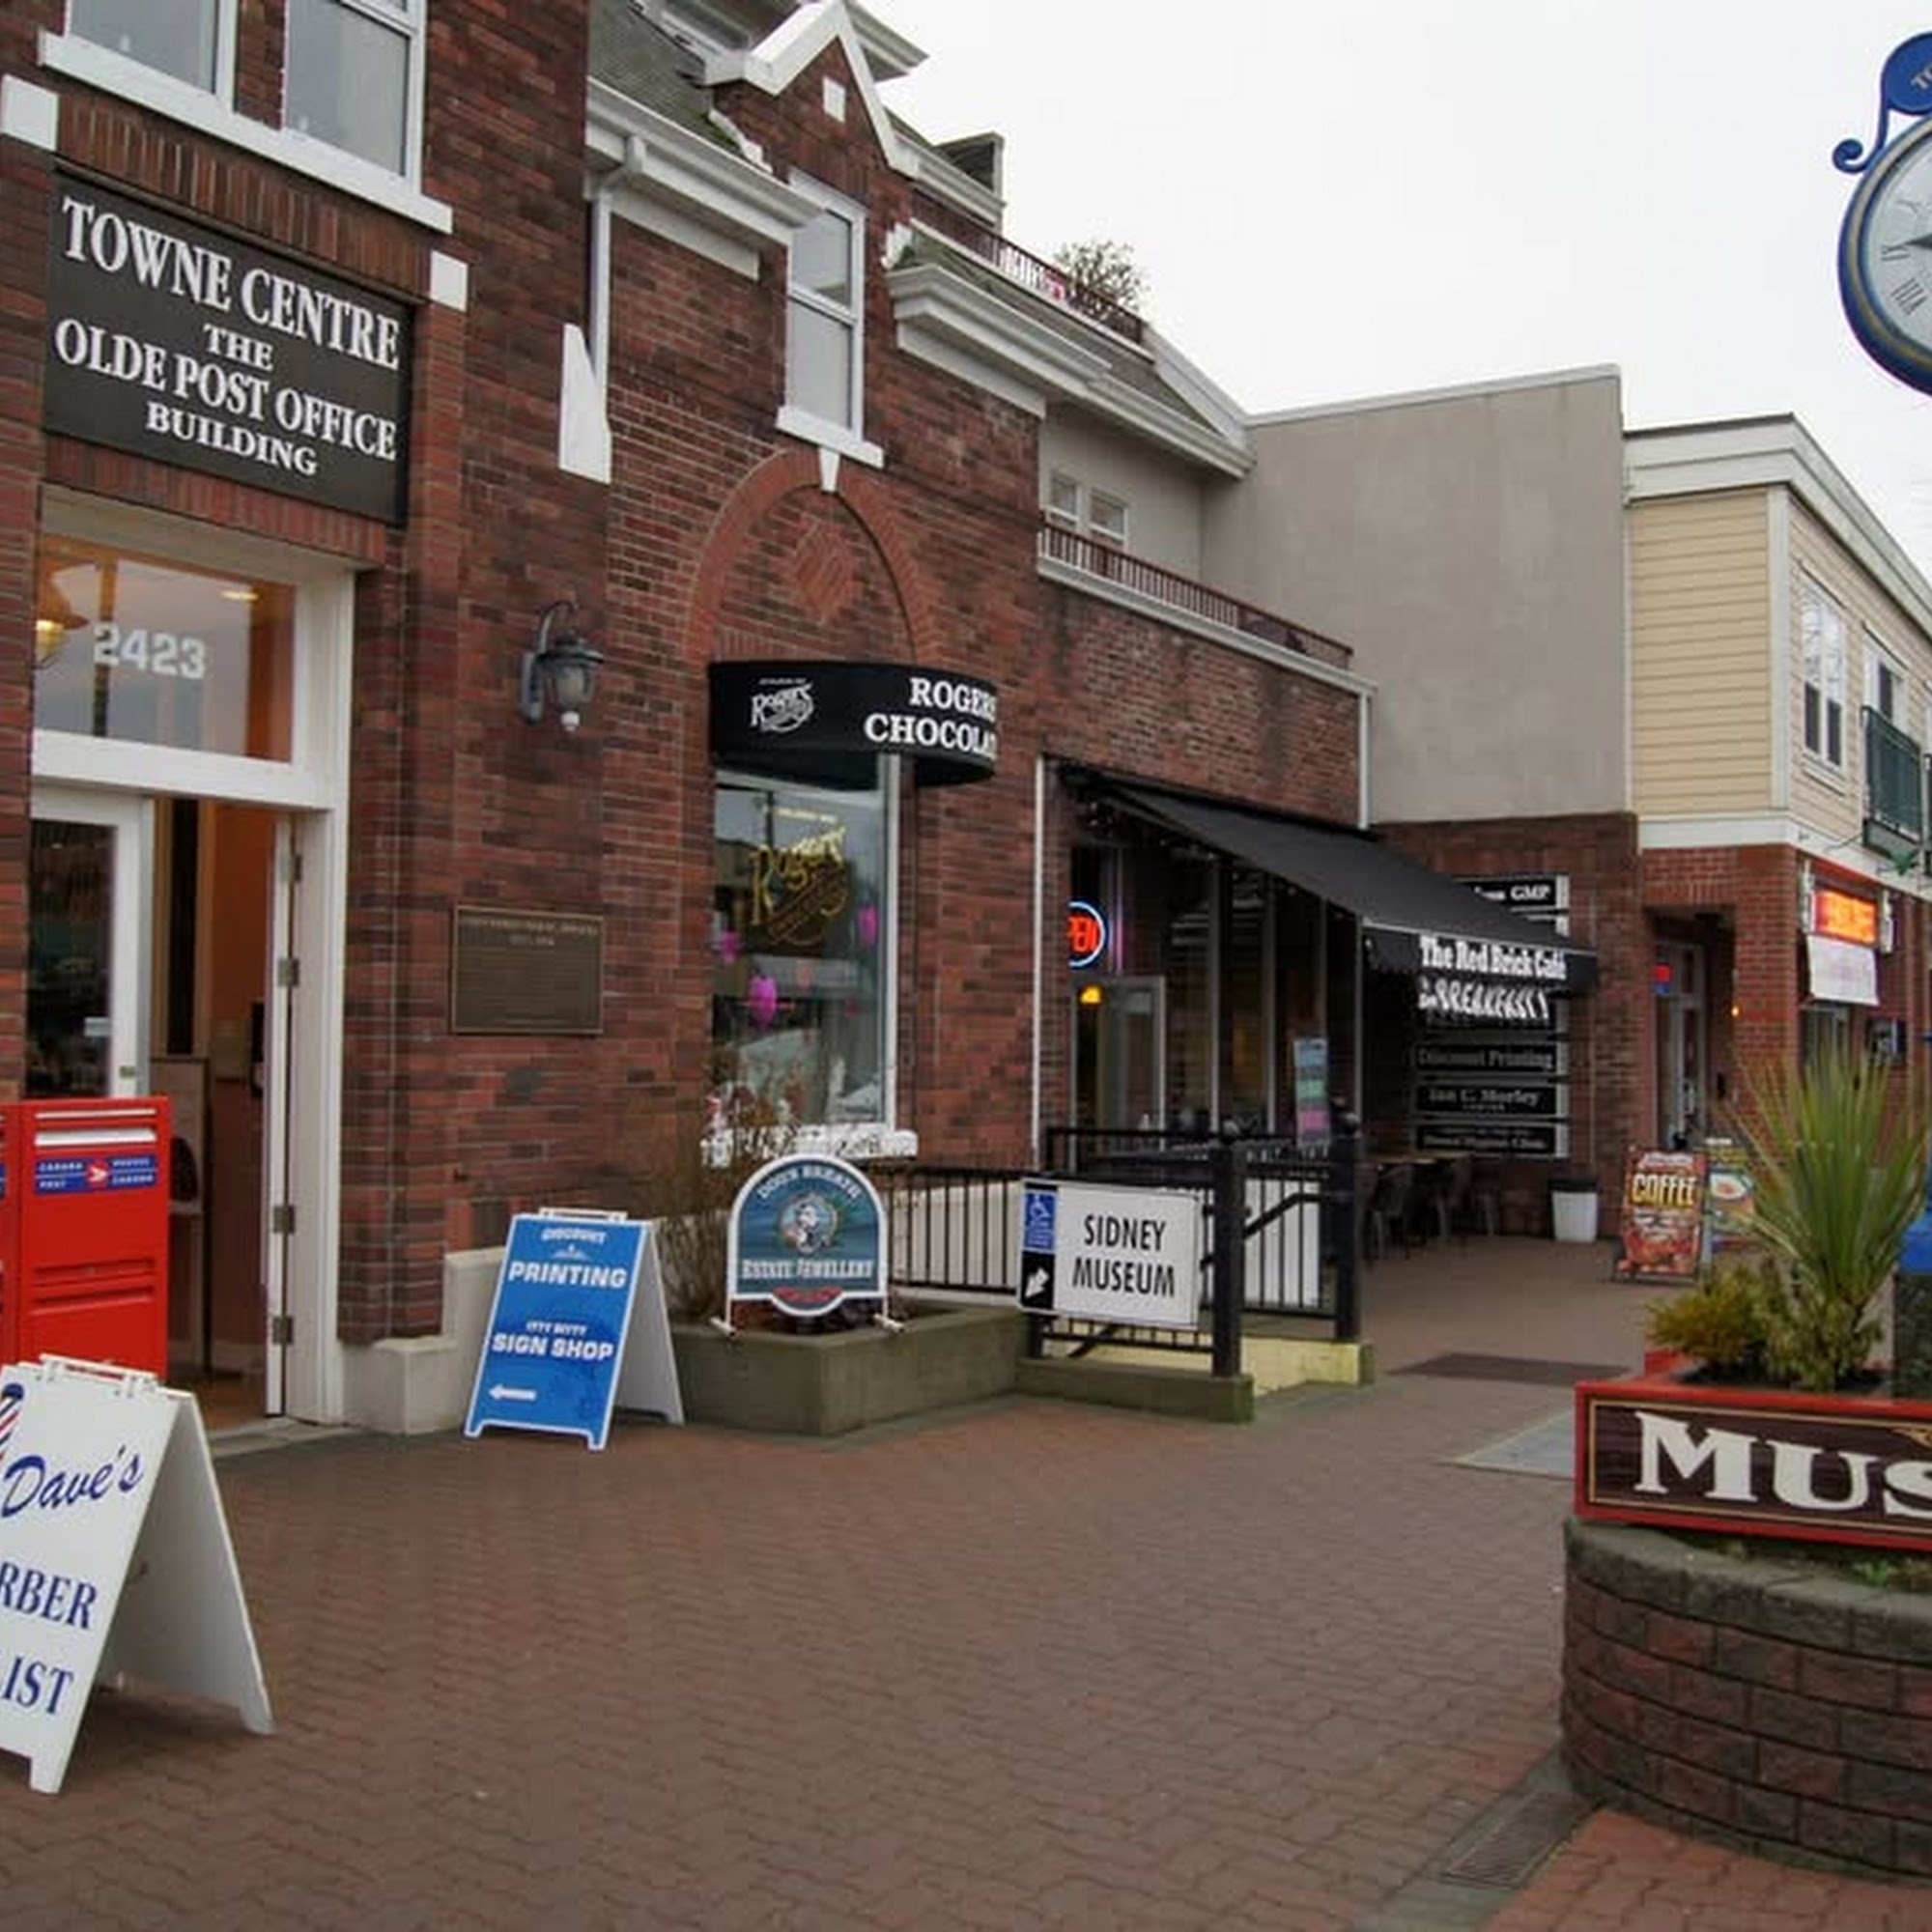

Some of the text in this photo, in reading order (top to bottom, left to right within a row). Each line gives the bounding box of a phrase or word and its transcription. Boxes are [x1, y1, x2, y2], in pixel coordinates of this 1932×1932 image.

[62, 197, 400, 371] TOWNE CENTRE
[203, 324, 273, 371] THE
[55, 318, 397, 461] OLDE POST OFFICE
[146, 401, 318, 475] BUILDING
[94, 621, 207, 680] 2423
[1419, 934, 1453, 969] The
[1456, 940, 1489, 974] Red
[1084, 1213, 1167, 1252] SIDNEY
[508, 1261, 628, 1289] PRINTING
[1072, 1257, 1176, 1298] MUSEUM
[492, 1332, 614, 1362] SIGN SHOP
[1, 1444, 144, 1518] Dave's
